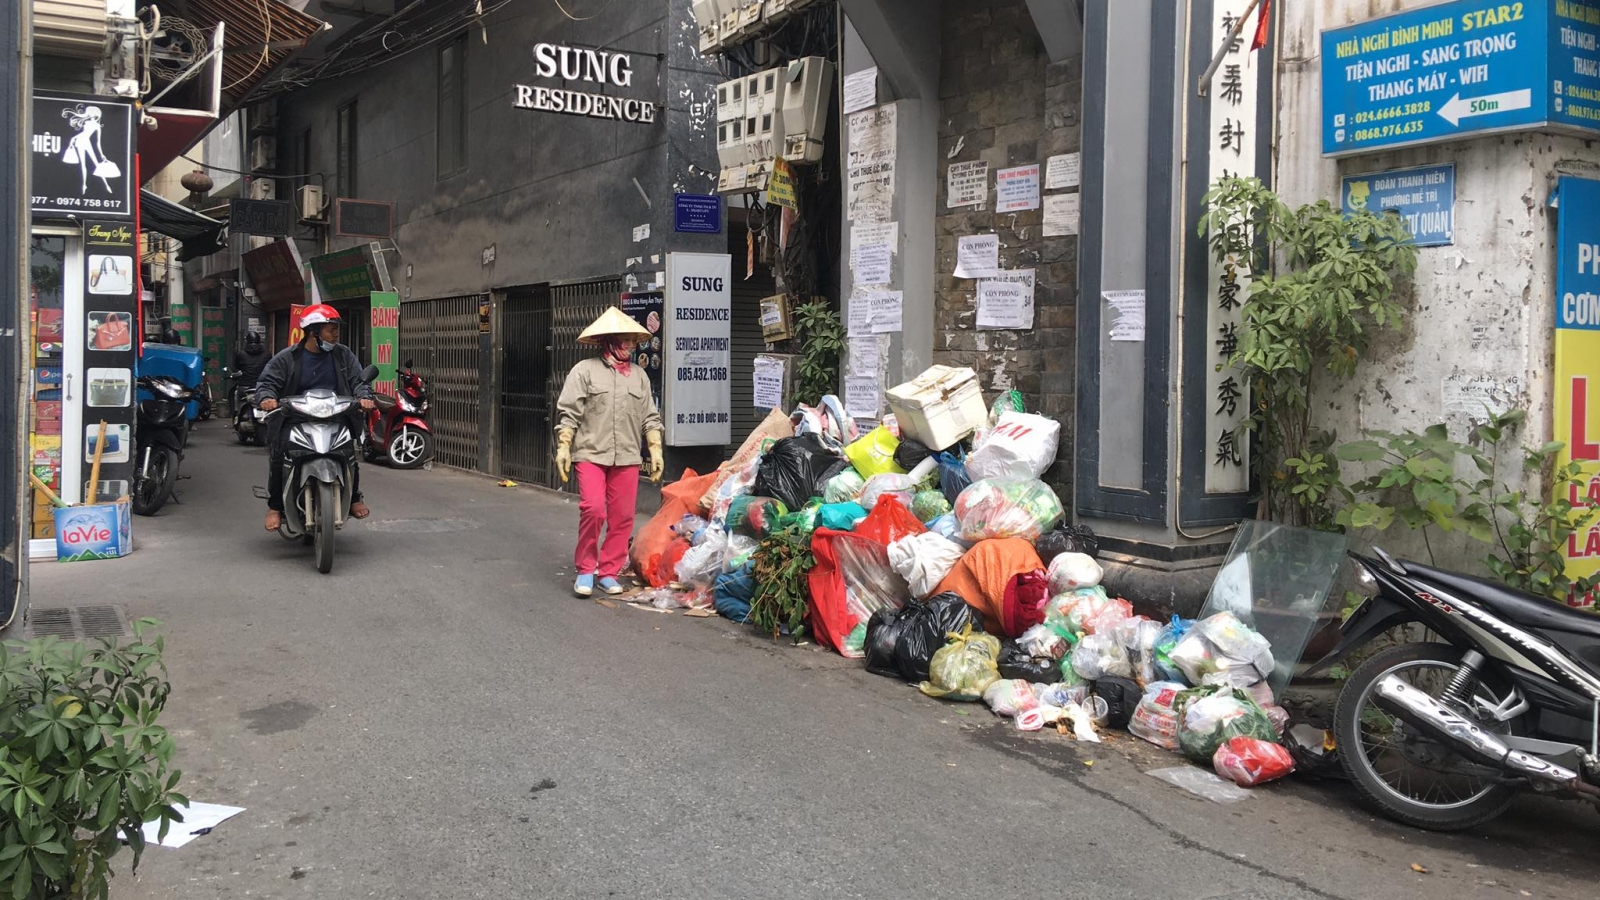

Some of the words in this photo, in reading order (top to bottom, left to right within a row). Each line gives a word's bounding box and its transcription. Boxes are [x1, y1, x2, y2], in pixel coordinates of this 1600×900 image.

[1336, 40, 1359, 58] NHÀ
[1362, 32, 1390, 52] NGHỈ
[1392, 25, 1420, 46] BÌNH
[1422, 18, 1453, 41] MINH
[1462, 2, 1524, 32] STAR2
[1578, 31, 1596, 50] NGHI
[534, 42, 633, 86] SUNG
[1346, 59, 1372, 82] TIỆN
[1376, 54, 1410, 77] NGHI
[1422, 44, 1460, 67] SANG
[1464, 32, 1517, 60] TRỌNG
[1368, 79, 1413, 102] THANG
[1417, 71, 1446, 94] MÁY
[1459, 64, 1489, 86] WIFI
[514, 83, 654, 123] RESIDENCE
[1470, 99, 1499, 113] 50m
[1355, 102, 1431, 124] 024.6666.3828
[1355, 120, 1424, 141] 0868.976.635
[1375, 176, 1395, 191] ĐOÀN
[1398, 175, 1423, 187] THANH
[1426, 171, 1445, 184] NIÊN
[57, 198, 80, 206] 0974
[83, 198, 101, 207] 758
[103, 199, 122, 208] 617
[1381, 192, 1410, 207] PHƯỜNG
[1421, 204, 1448, 236] QUẢN
[974, 241, 994, 249] PHÒNG
[682, 276, 723, 292] SUNG
[882, 296, 899, 306] PHÒNG
[372, 303, 398, 328] BÁNH
[676, 308, 729, 321] RESIDENCE
[676, 337, 700, 351] SERVICED
[701, 337, 729, 351] APARTMENT
[677, 367, 727, 381] 085.432.1368
[677, 414, 684, 423] ĐC
[689, 414, 696, 423] 32
[62, 525, 112, 544] laVie
